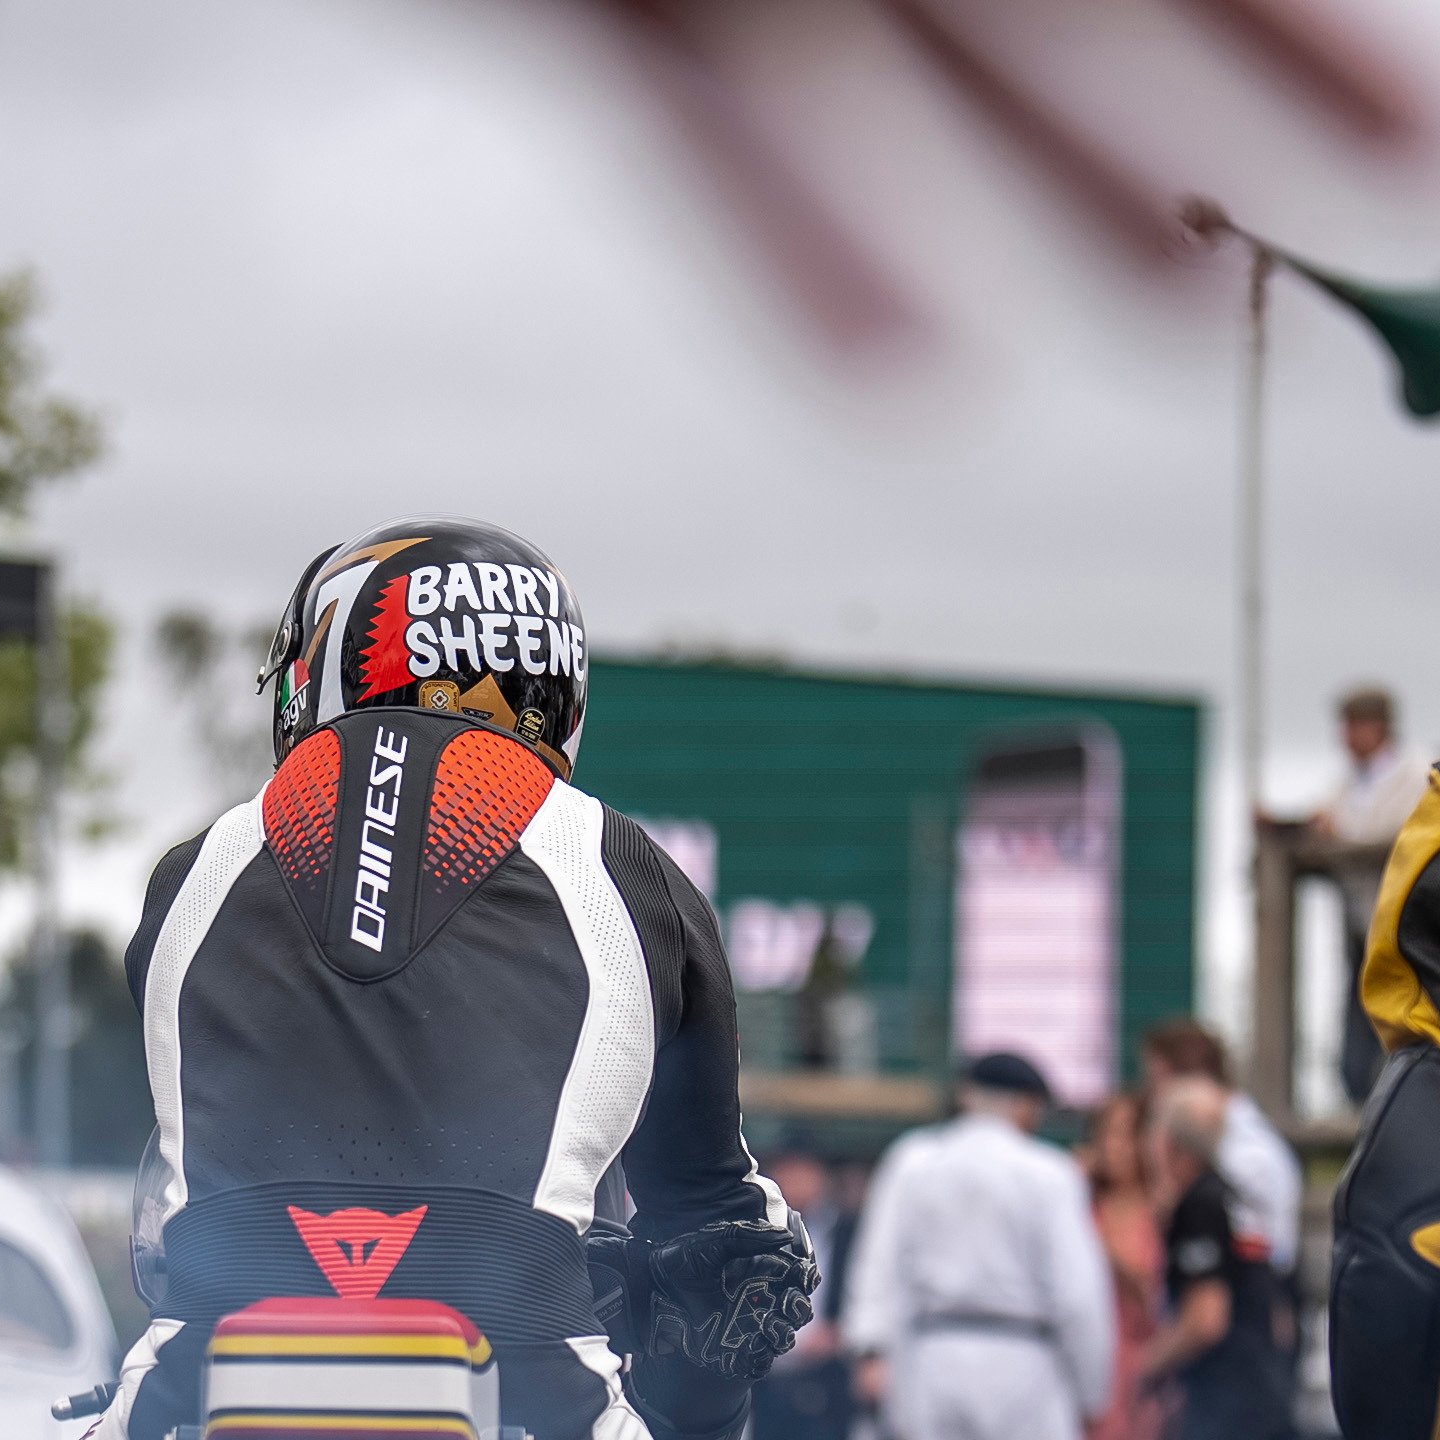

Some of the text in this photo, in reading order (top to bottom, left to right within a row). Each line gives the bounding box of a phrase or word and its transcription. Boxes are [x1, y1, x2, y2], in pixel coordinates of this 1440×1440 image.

[408, 562, 561, 617] BARRY
[405, 612, 585, 682] SHEENE
[283, 687, 307, 731] agv
[350, 725, 409, 953] DAINESE
